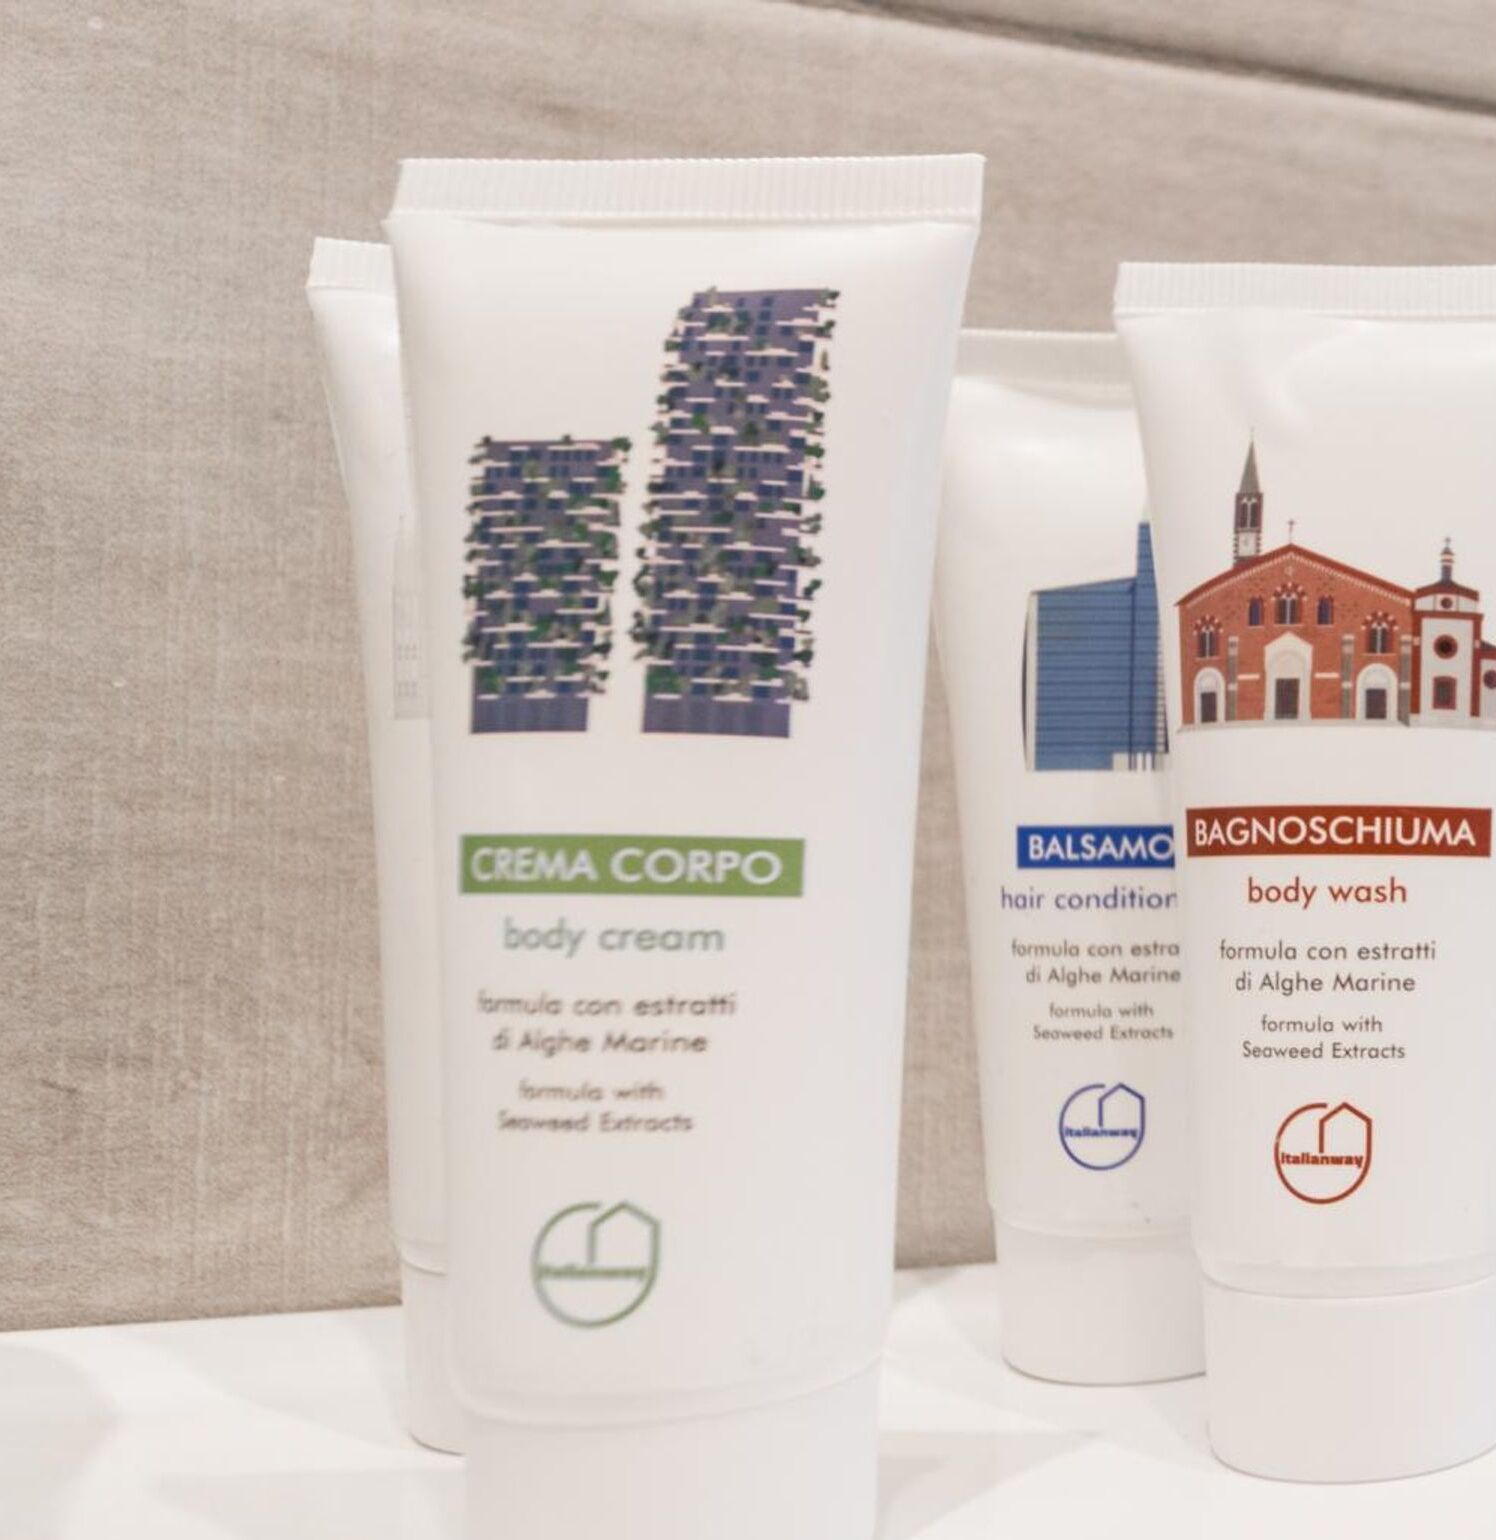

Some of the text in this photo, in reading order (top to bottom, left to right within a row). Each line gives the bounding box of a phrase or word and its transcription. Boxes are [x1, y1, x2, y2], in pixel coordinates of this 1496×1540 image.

[1194, 815, 1476, 846] BAGNOSCHIUMA
[1028, 833, 1174, 861] BALSAMO
[471, 846, 784, 885] CREMA CORPO
[1000, 885, 1178, 910] hair condition
[1248, 876, 1407, 910] body wash
[503, 917, 726, 959] body cream
[1011, 939, 1181, 957] formula con estra
[1219, 939, 1436, 960] formula con estratti
[1025, 966, 1182, 988] di Alghe Marine
[1235, 971, 1416, 996] di Alghe Marine
[573, 997, 622, 1016] con
[633, 991, 738, 1016] estratti
[1049, 1001, 1154, 1018] formula with
[1032, 1025, 1174, 1040] Seaweed Extracts
[1261, 1014, 1383, 1033] formula with
[517, 1028, 592, 1058] Alghe
[603, 1030, 709, 1053] Marine
[1242, 1041, 1406, 1059] Seaweed Extracts
